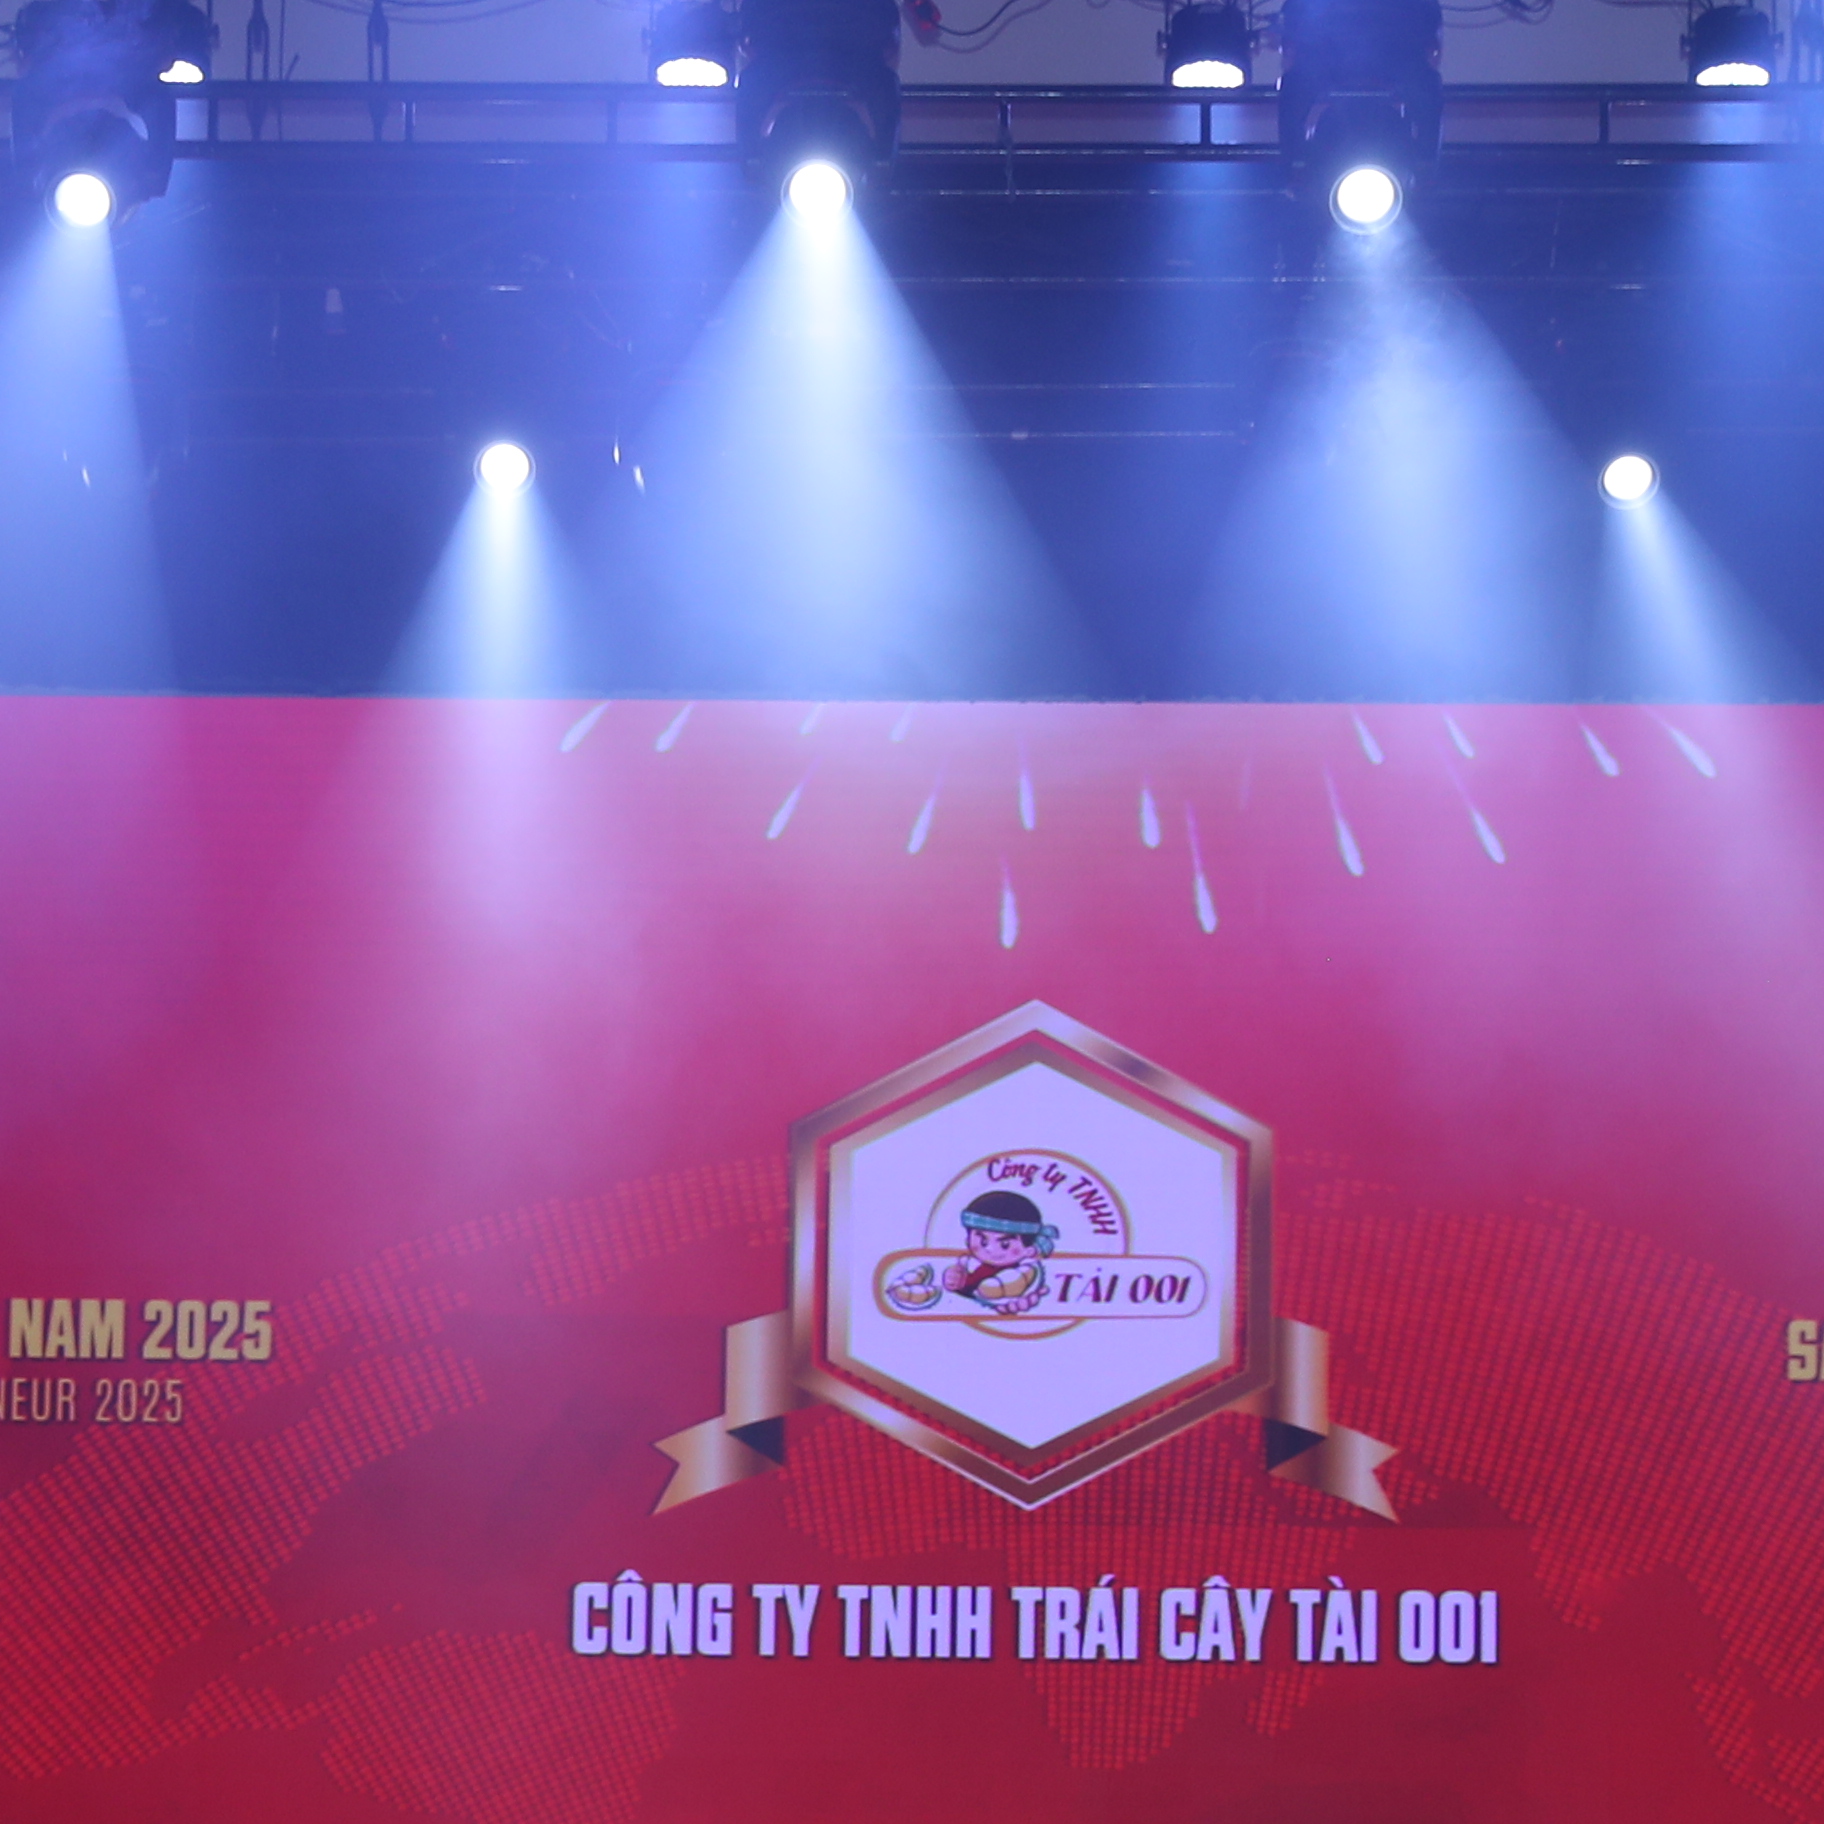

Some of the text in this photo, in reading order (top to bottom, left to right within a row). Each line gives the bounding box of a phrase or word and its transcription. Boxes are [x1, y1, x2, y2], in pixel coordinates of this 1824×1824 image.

[987, 1158, 1041, 1187] Công
[1067, 1176, 1119, 1235] TNHH
[1128, 1273, 1192, 1304] 001
[9, 1296, 124, 1359] NAM
[143, 1298, 273, 1361] 2025
[95, 1378, 183, 1424] 2025
[572, 1568, 1498, 1664] CÔNG TY TNHH TRÁI CÂY TÀI 001
